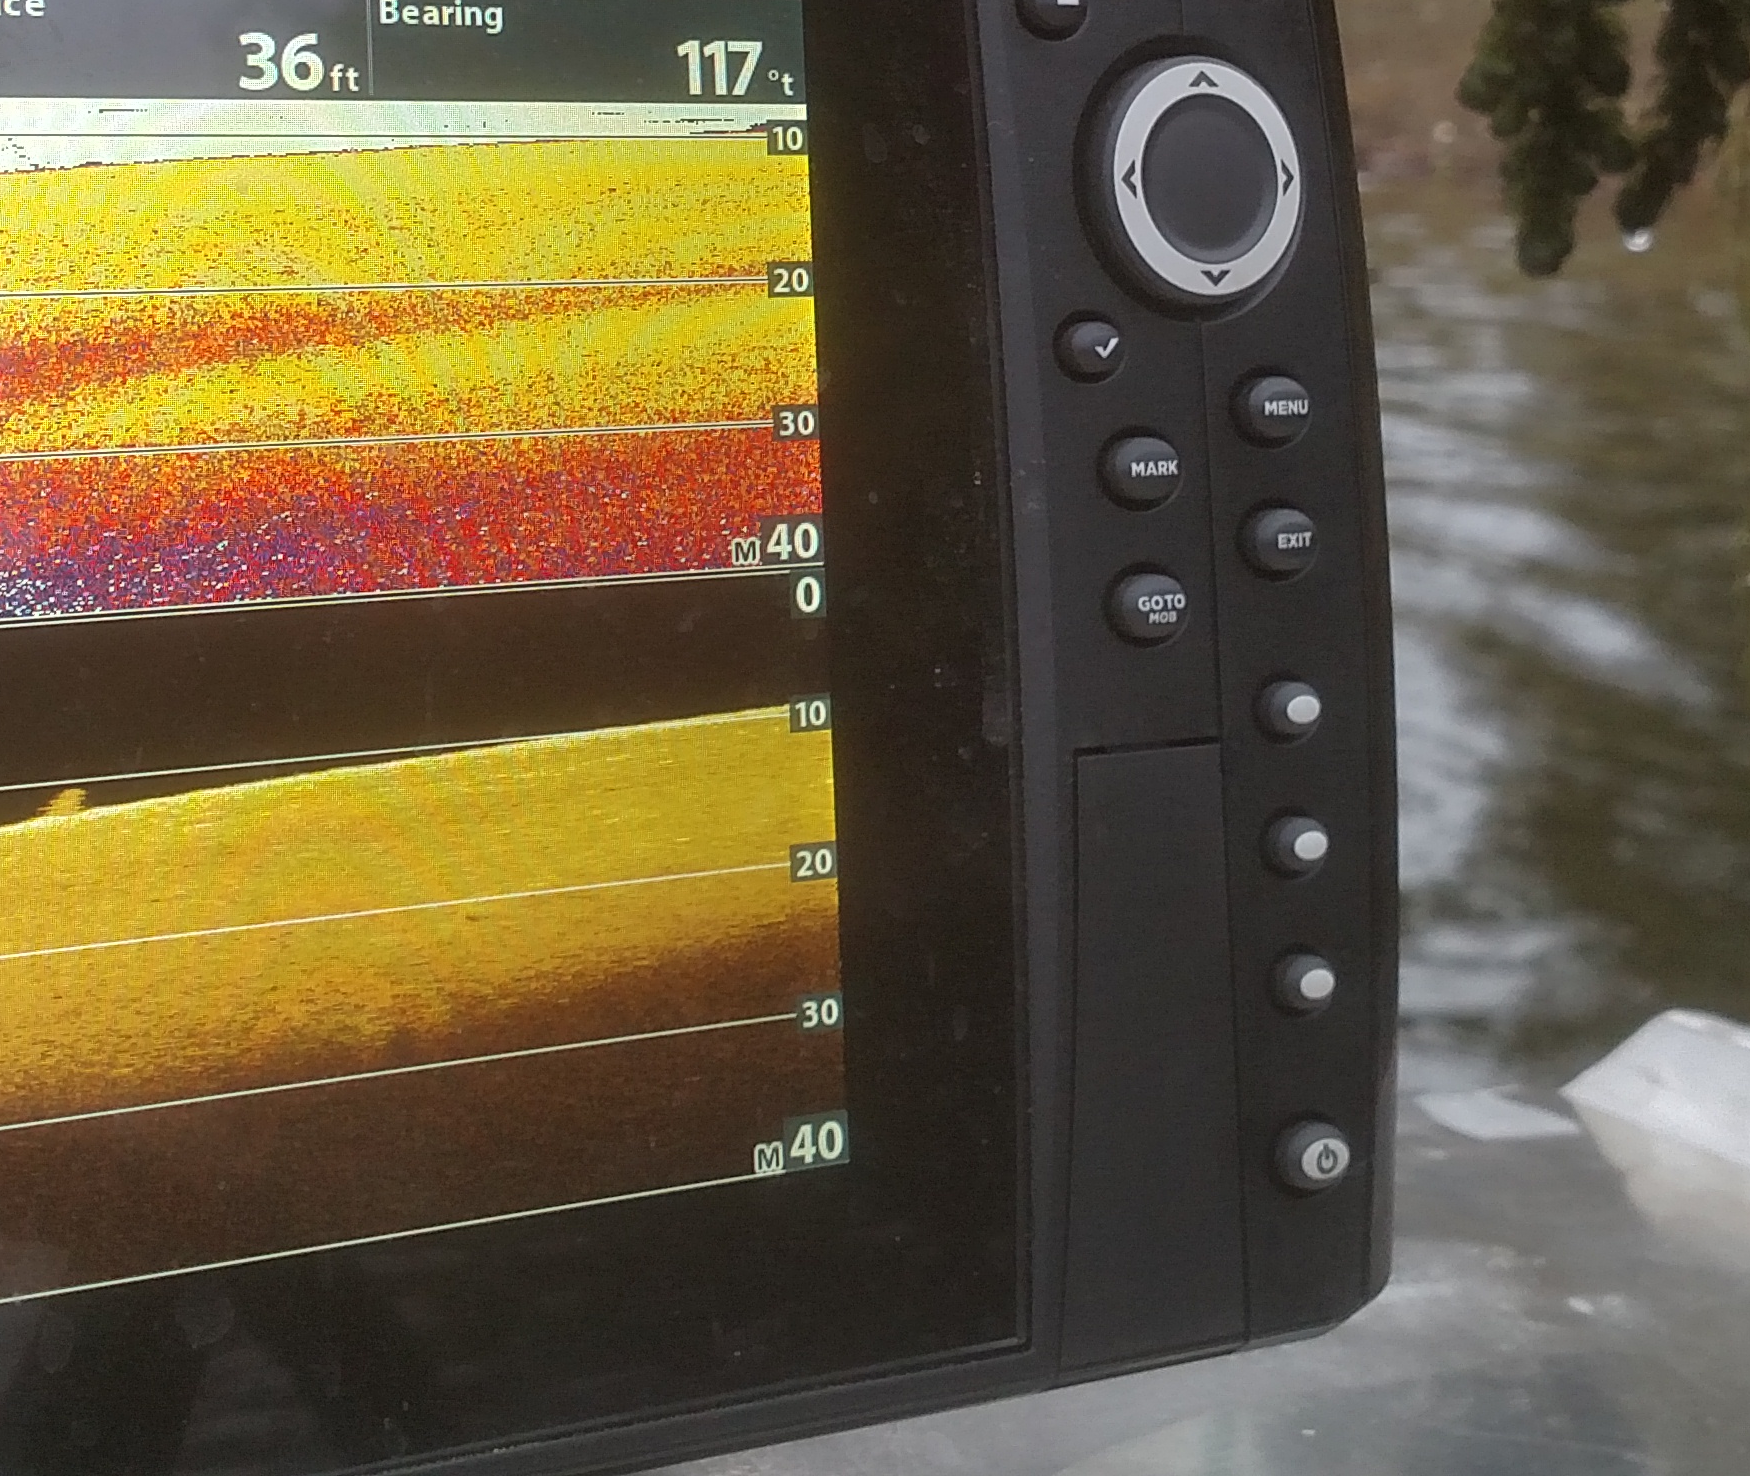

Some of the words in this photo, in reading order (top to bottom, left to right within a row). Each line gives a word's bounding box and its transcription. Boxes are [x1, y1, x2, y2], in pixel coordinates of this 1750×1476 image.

[677, 40, 763, 97] 117
[769, 126, 804, 152] 10
[772, 267, 809, 294] 20
[1264, 398, 1309, 417] MENU
[778, 410, 815, 436] 30
[1130, 458, 1179, 478] MARK
[766, 521, 819, 559] 40
[1277, 530, 1313, 549] EXIT
[794, 577, 821, 614] 0
[1137, 593, 1187, 613] GOTO
[1148, 612, 1178, 625] MOB
[795, 700, 827, 728] 10
[796, 847, 833, 878] 20
[802, 998, 839, 1029] 30
[790, 1121, 843, 1164] 40
